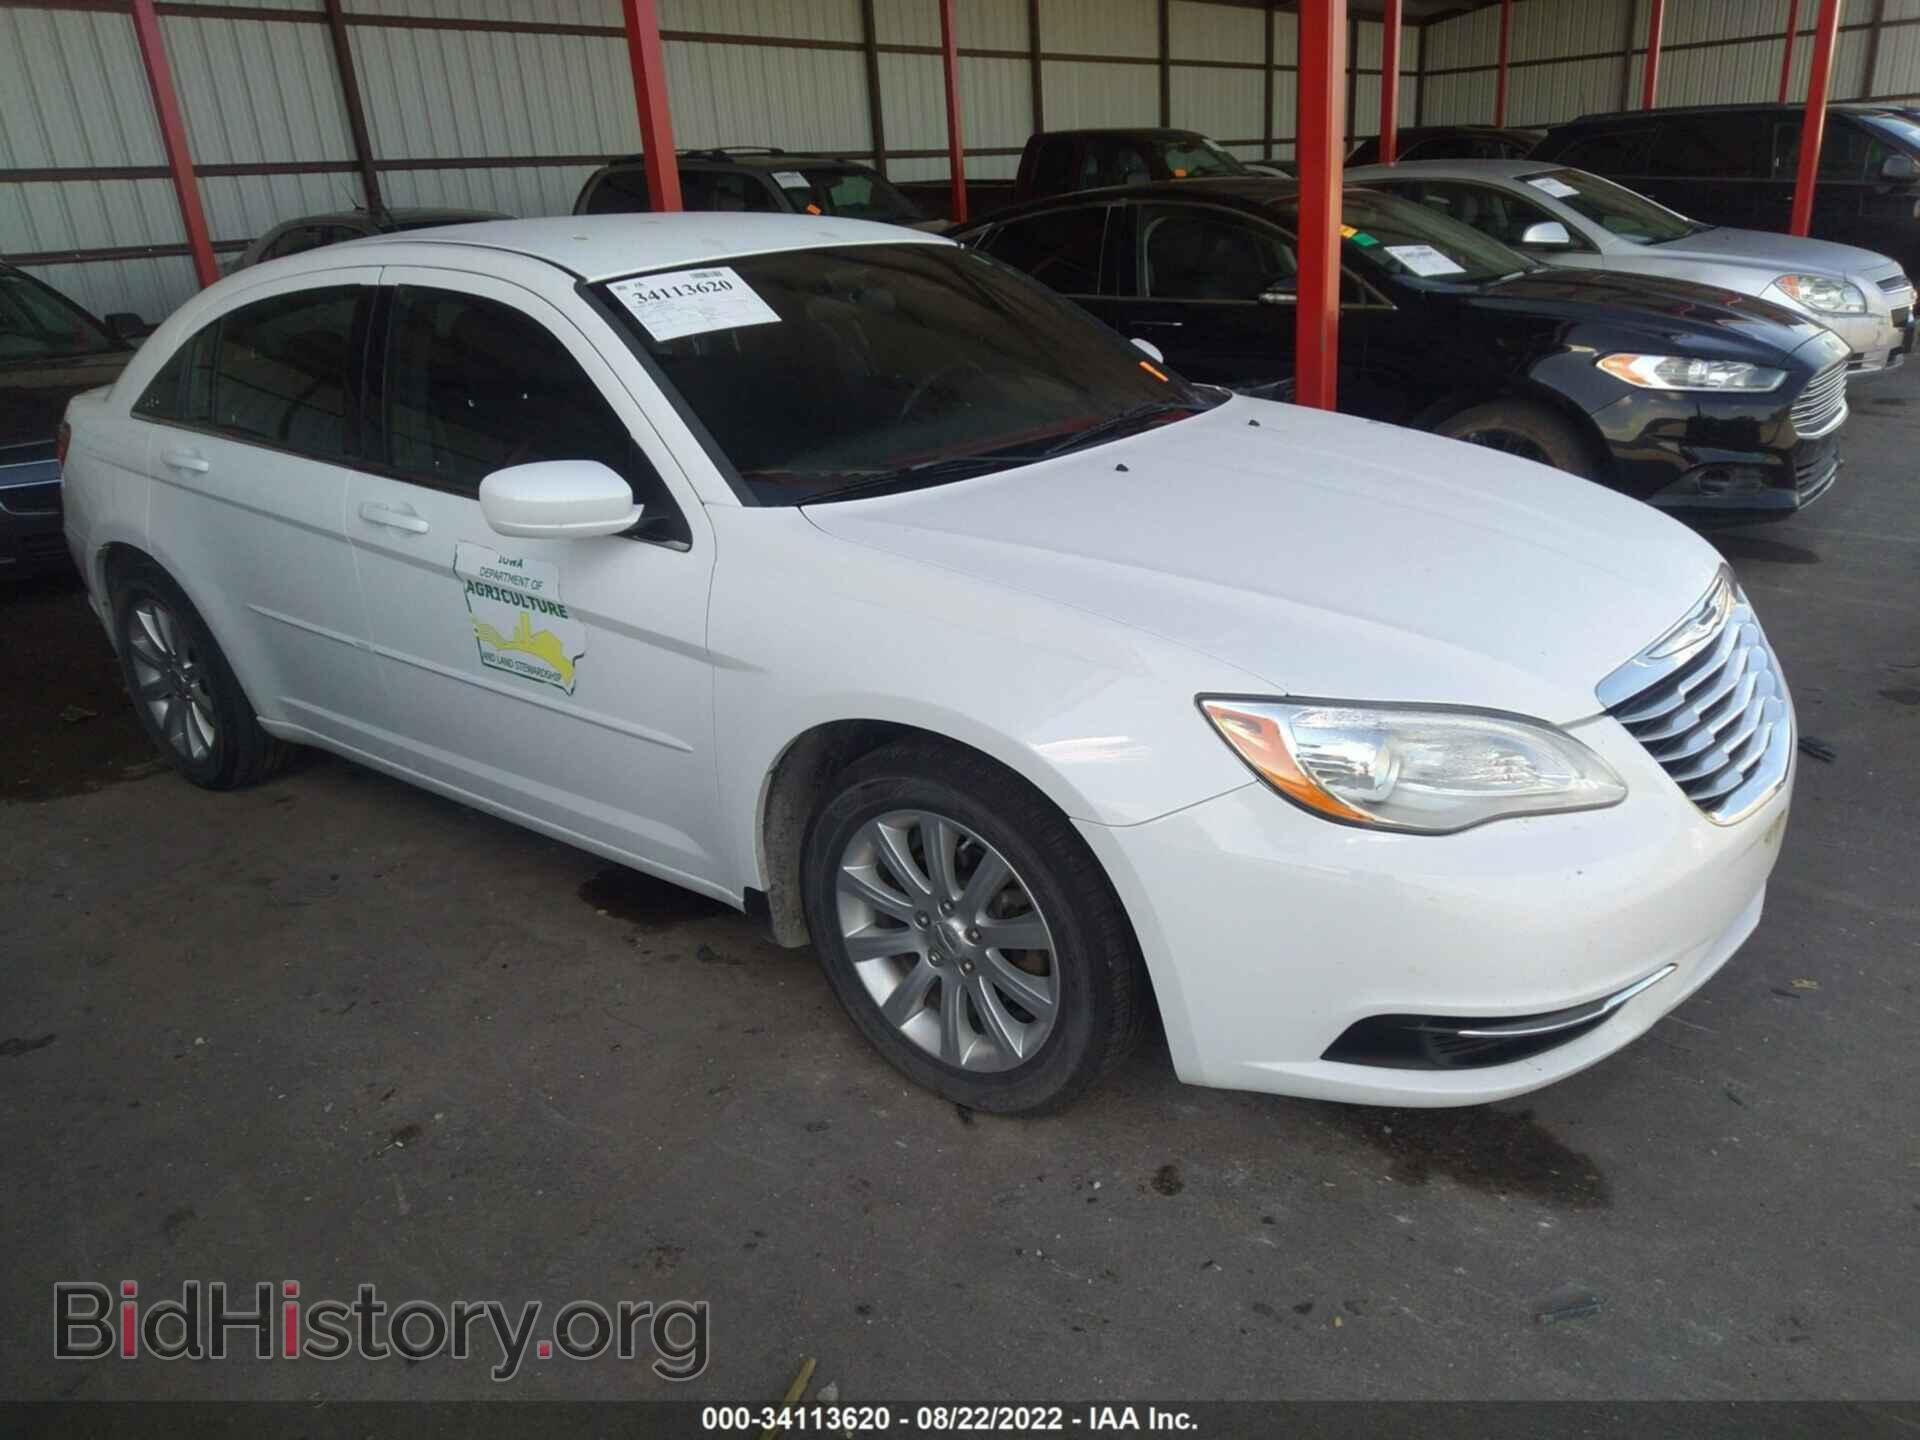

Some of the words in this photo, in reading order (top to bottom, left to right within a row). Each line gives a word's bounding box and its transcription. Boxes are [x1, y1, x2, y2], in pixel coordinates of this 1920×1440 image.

[632, 280, 733, 304] 34113620
[479, 566, 531, 587] DEPARTMENT
[531, 580, 544, 591] OF
[465, 580, 568, 619] AGRICULTURE
[497, 655, 514, 668] LAND
[515, 660, 562, 682] STEWARDSHIP
